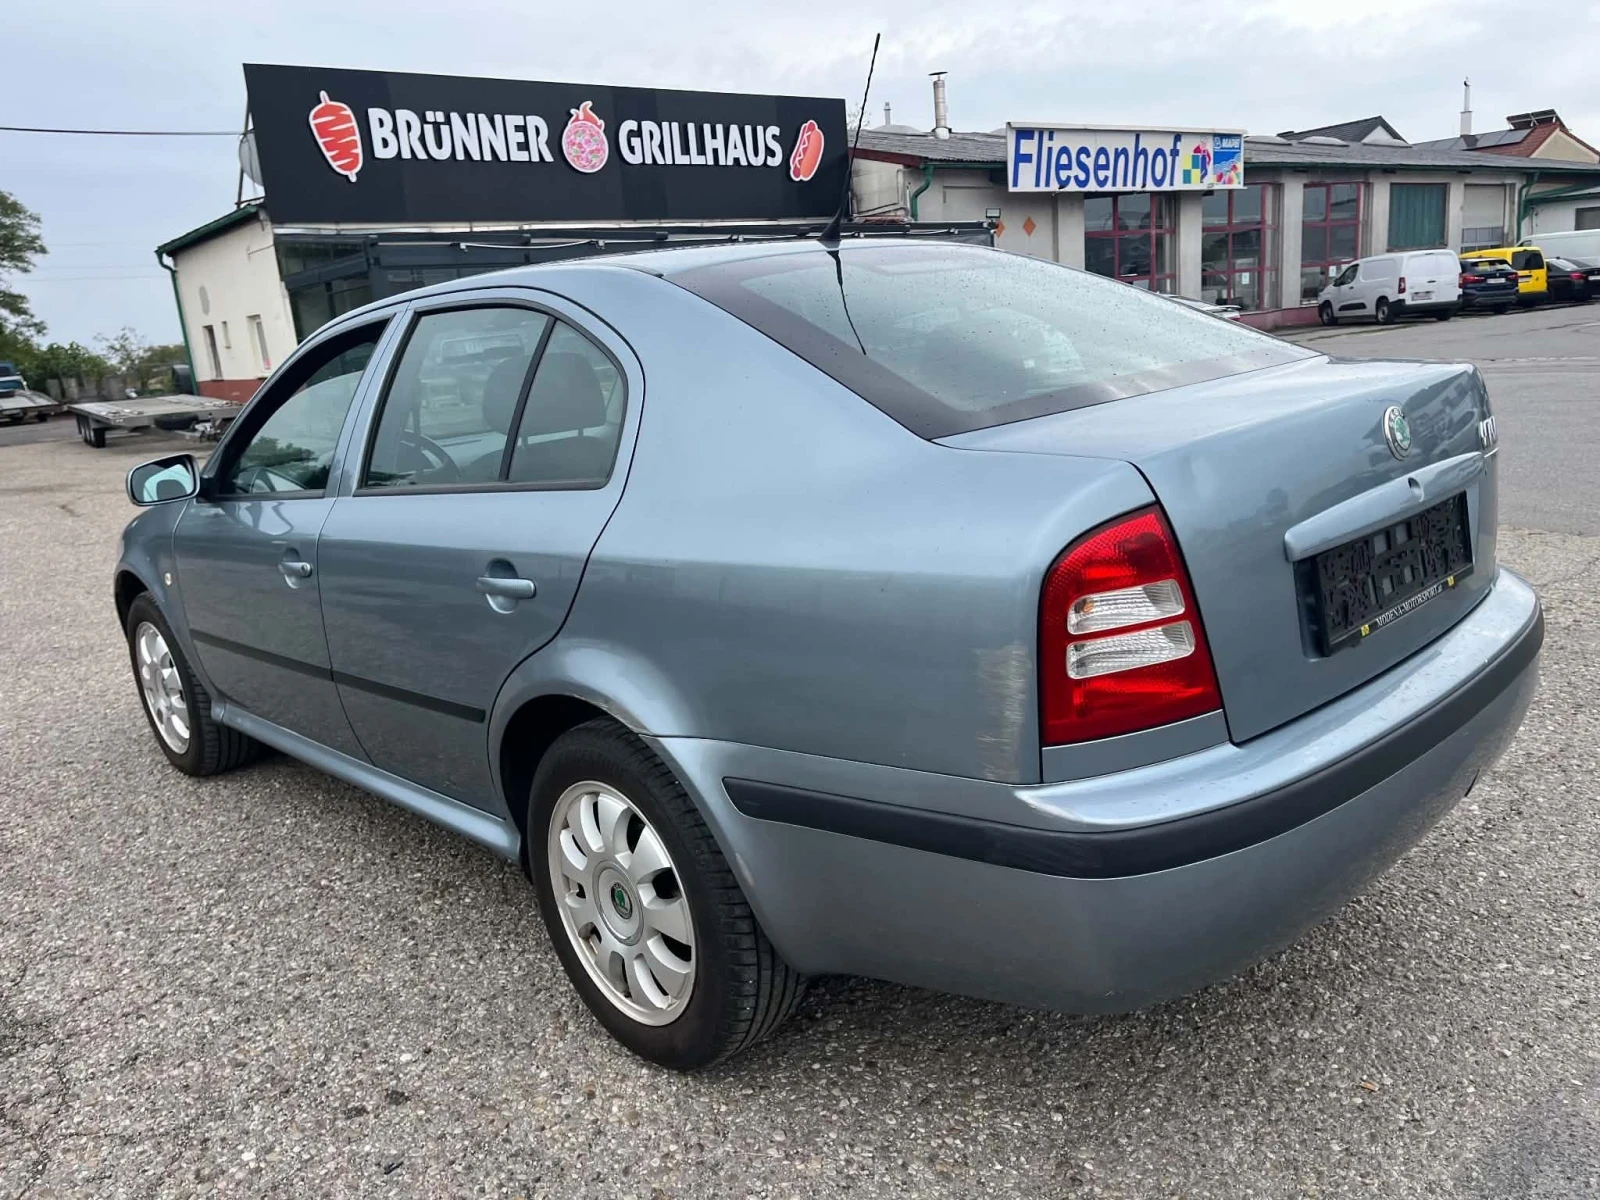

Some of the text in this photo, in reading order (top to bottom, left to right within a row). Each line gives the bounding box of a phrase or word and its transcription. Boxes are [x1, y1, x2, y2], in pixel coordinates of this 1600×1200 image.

[368, 106, 783, 168] BRÜNNER GRILLHAUS
[1012, 129, 1182, 190] Fliesenhof
